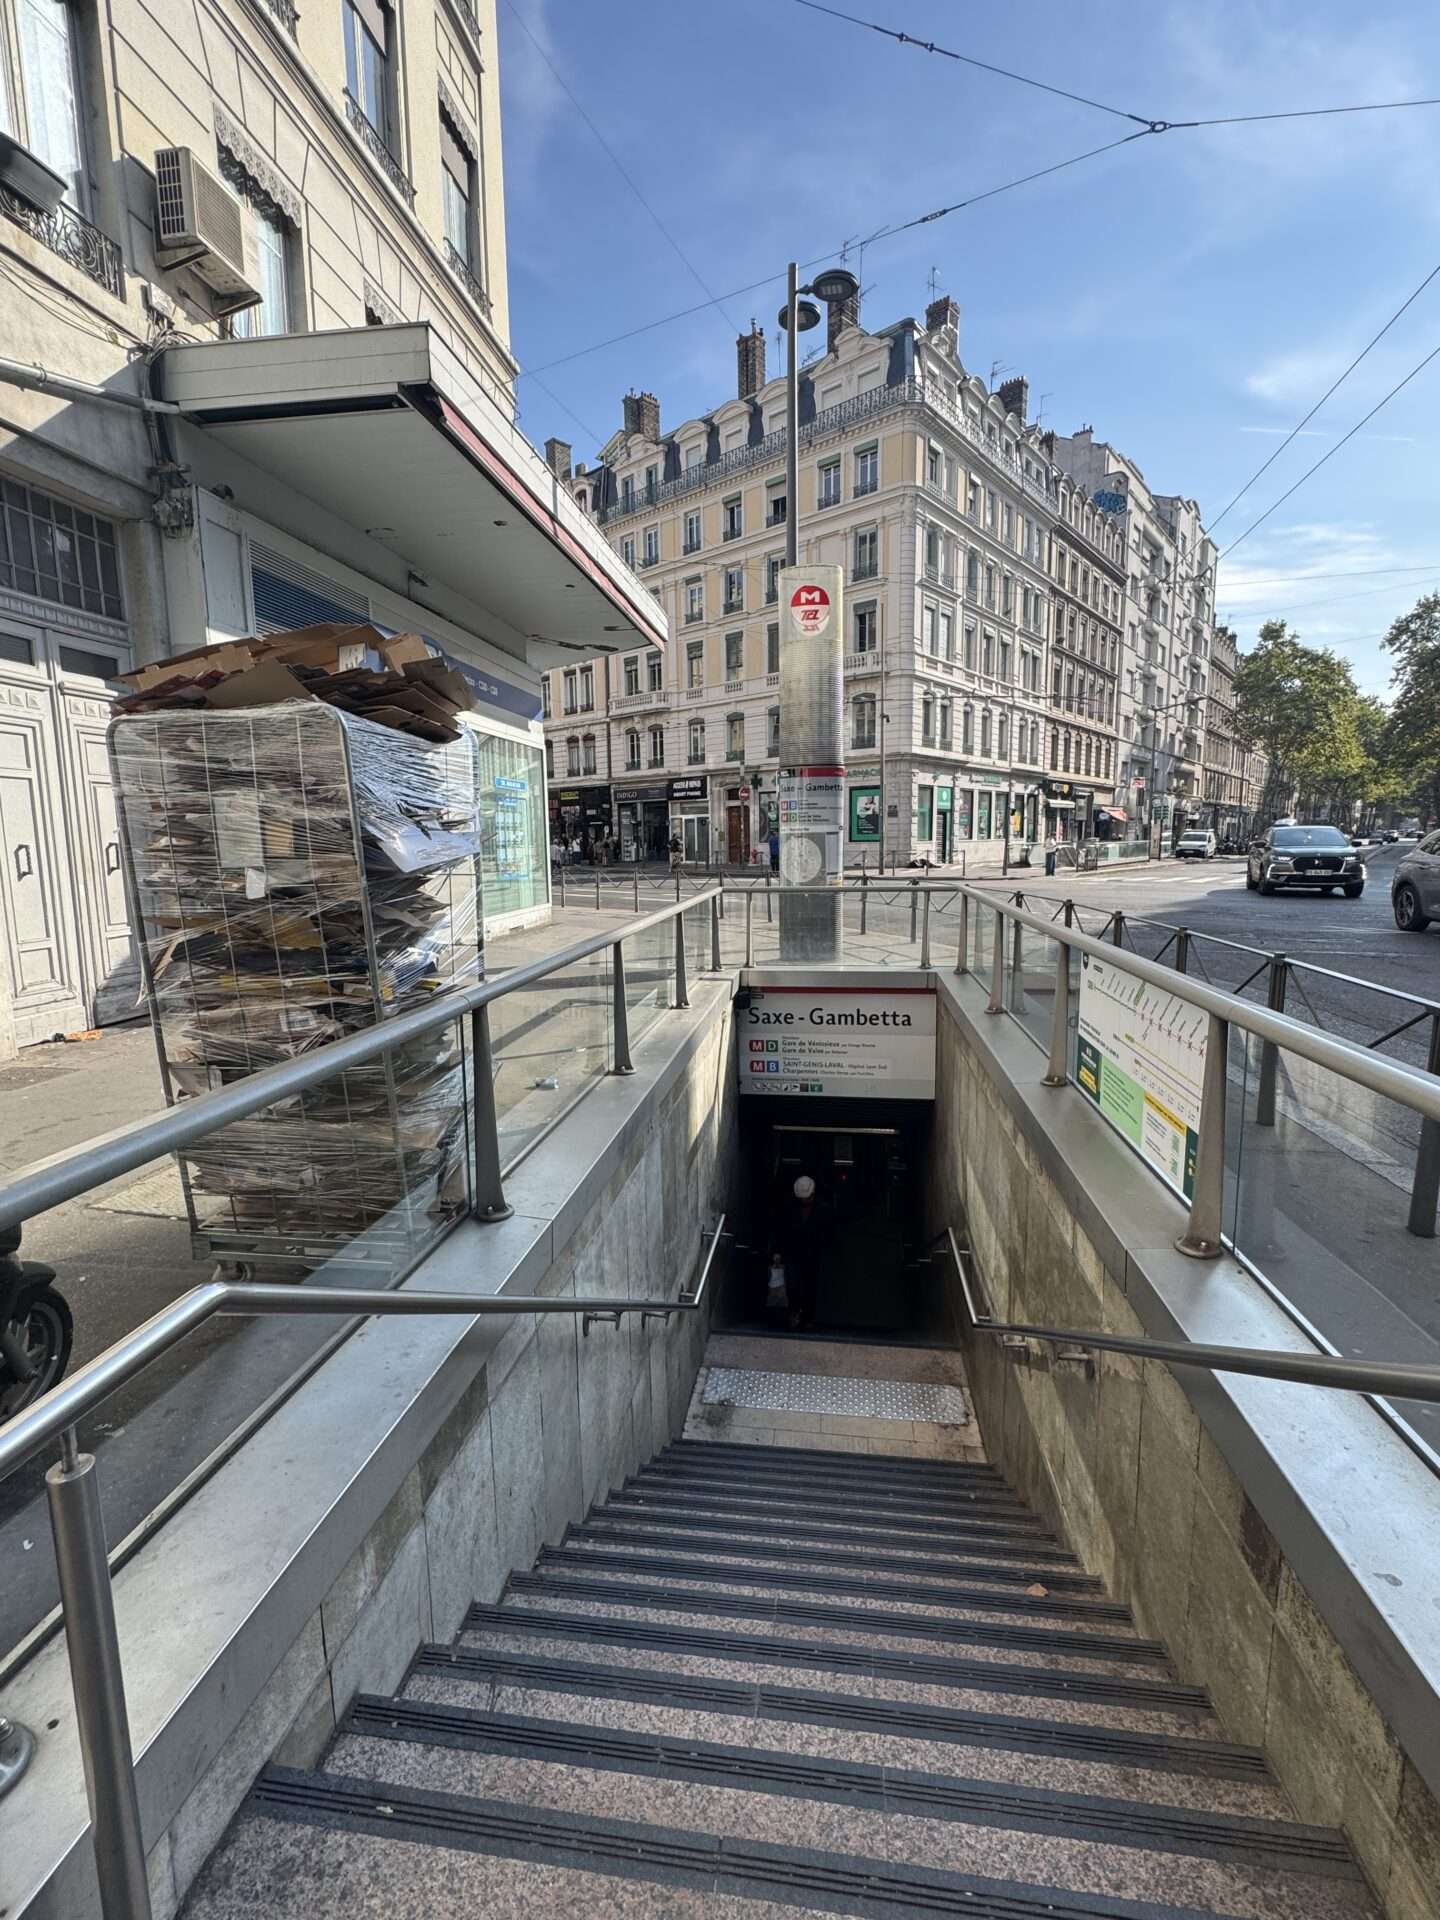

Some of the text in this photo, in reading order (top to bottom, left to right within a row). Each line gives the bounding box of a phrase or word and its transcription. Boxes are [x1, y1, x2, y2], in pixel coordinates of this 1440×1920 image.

[800, 590, 820, 604] M
[748, 1006, 795, 1025] Saxe
[809, 1007, 913, 1027] Gambetta
[752, 1041, 777, 1051] M D
[752, 1061, 763, 1072] M
